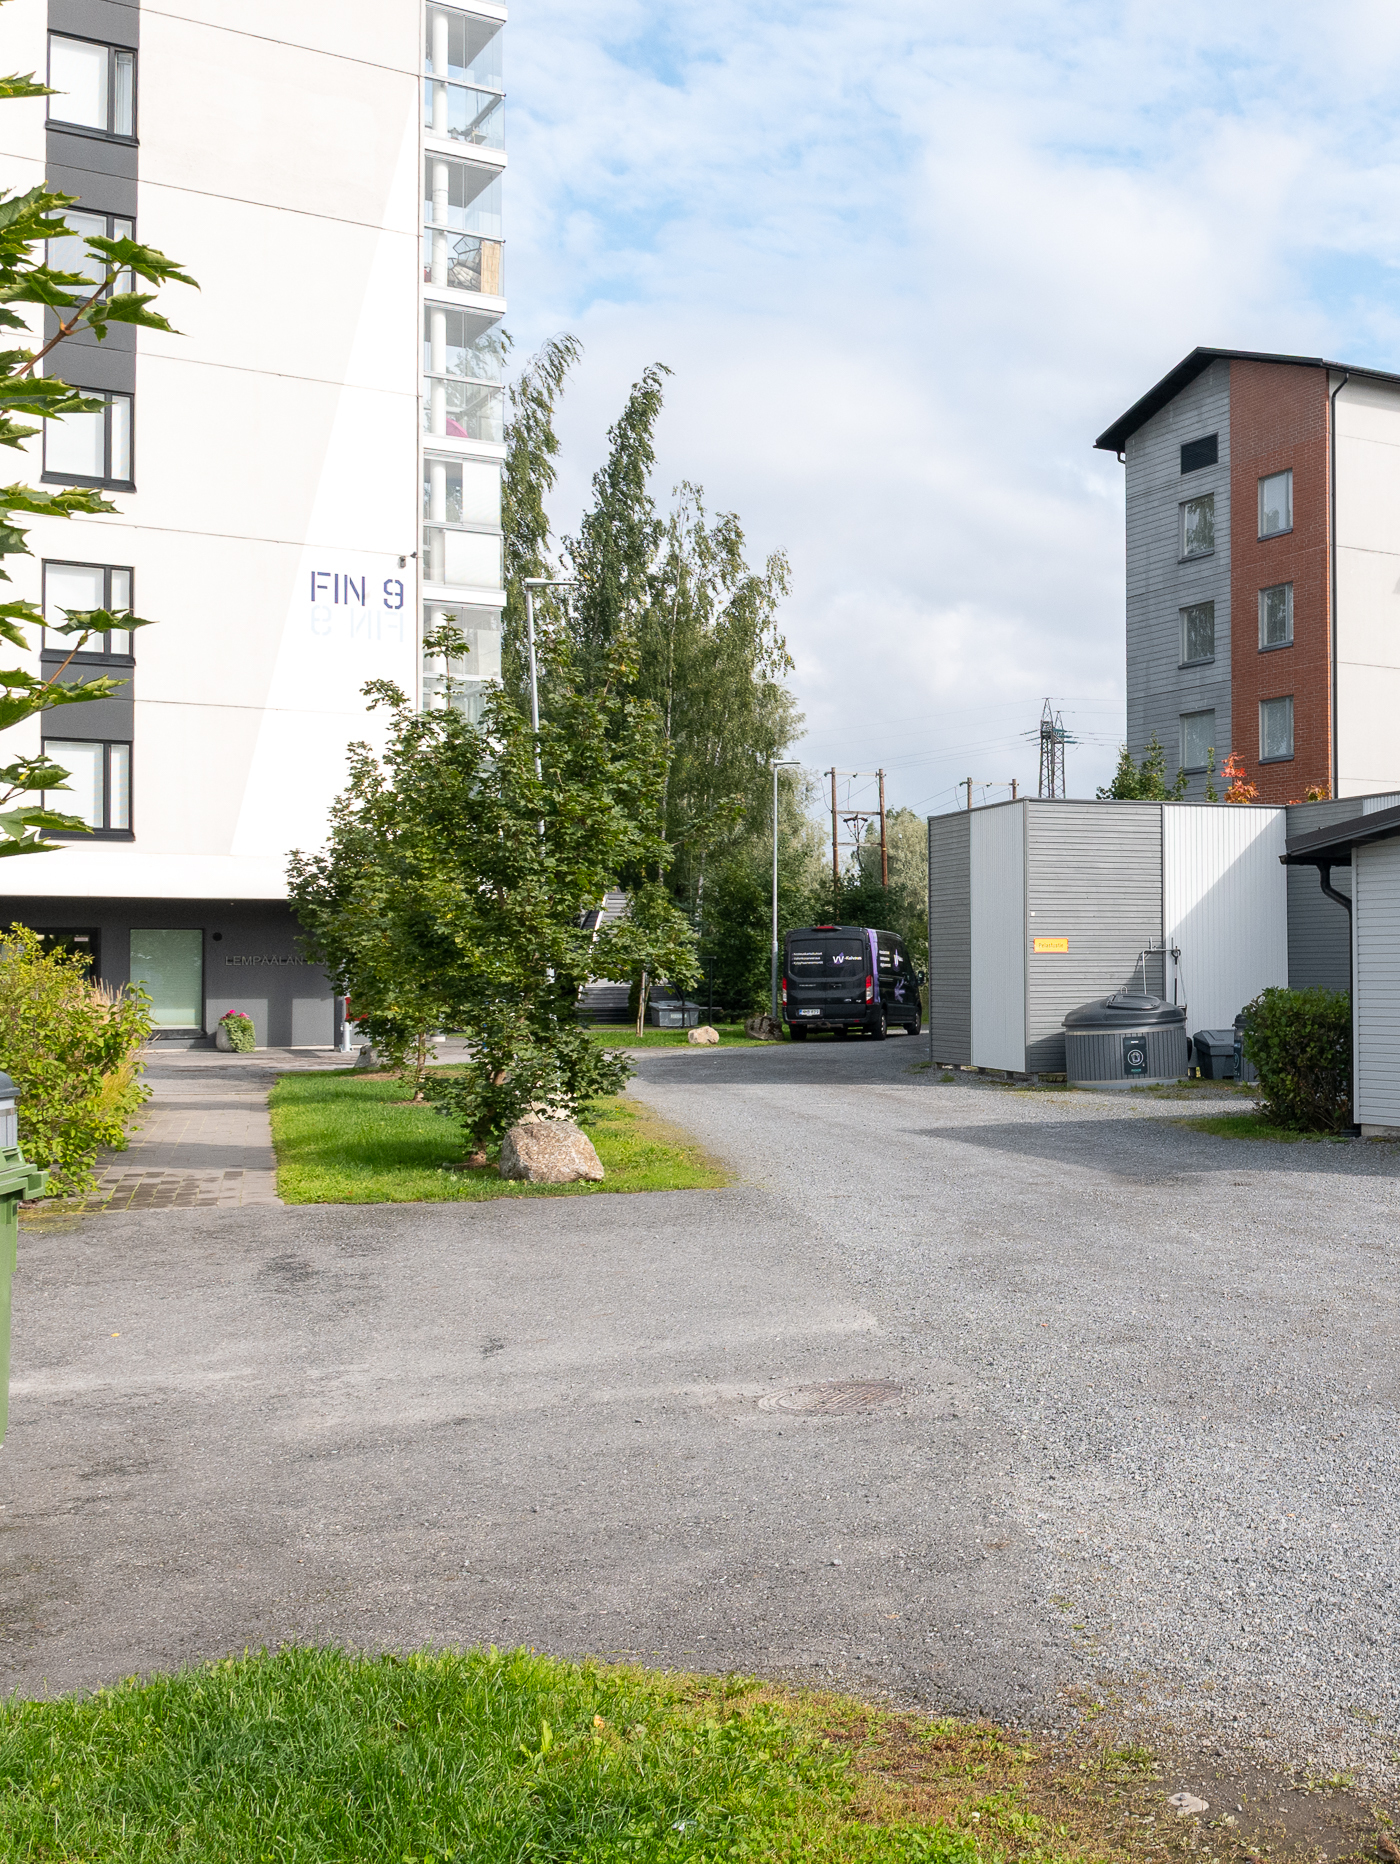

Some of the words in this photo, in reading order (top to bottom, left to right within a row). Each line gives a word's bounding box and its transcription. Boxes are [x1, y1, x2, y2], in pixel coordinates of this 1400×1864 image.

[311, 570, 365, 606] FIN
[383, 578, 404, 610] 9
[225, 954, 303, 966] LEMPÄÄLÄN
